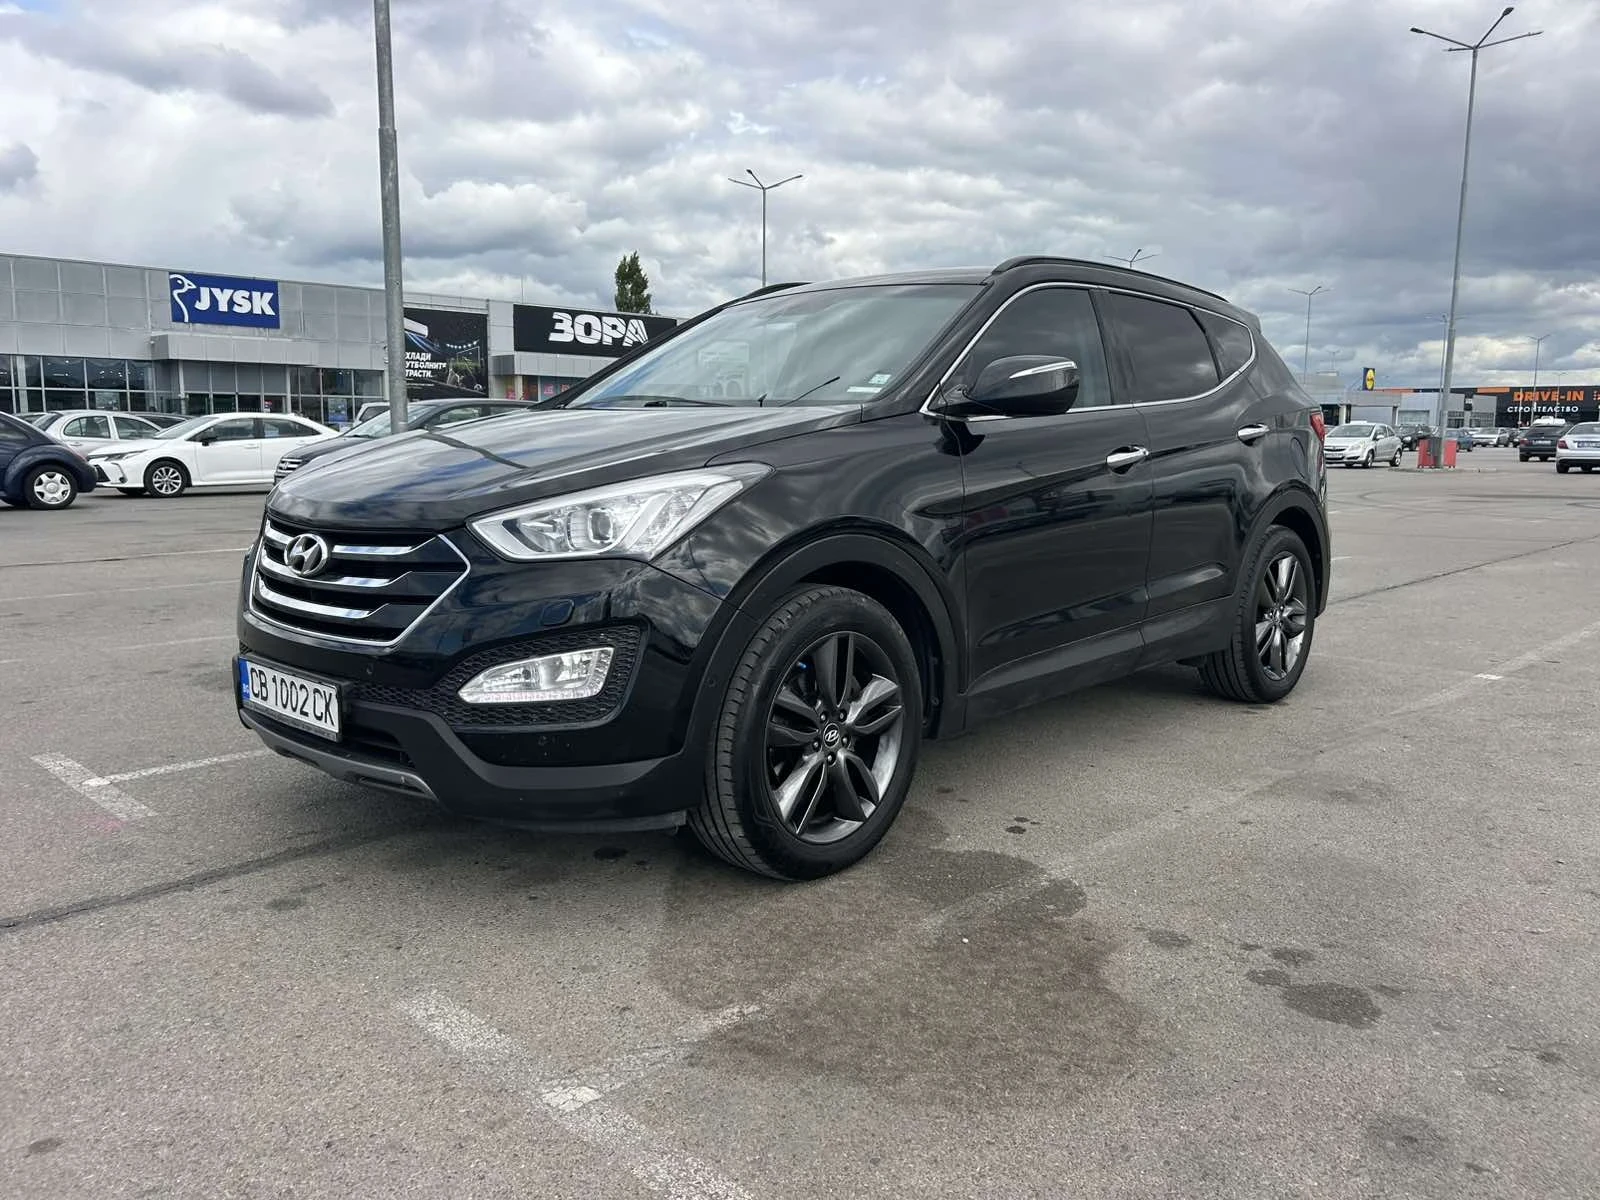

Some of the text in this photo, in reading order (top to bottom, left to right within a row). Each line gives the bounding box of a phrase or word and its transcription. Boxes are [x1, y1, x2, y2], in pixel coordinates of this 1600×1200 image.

[194, 286, 276, 316] JYSK
[549, 311, 649, 347] ЗОРА
[404, 351, 432, 362] ХЛАДИ
[405, 360, 447, 370] УТБОЛНИТЕ
[405, 369, 433, 378] ТРАСТИ.
[1513, 391, 1584, 401] DRIVE-IN
[250, 667, 269, 702] CB
[272, 674, 309, 717] 1002
[313, 688, 335, 726] CX
